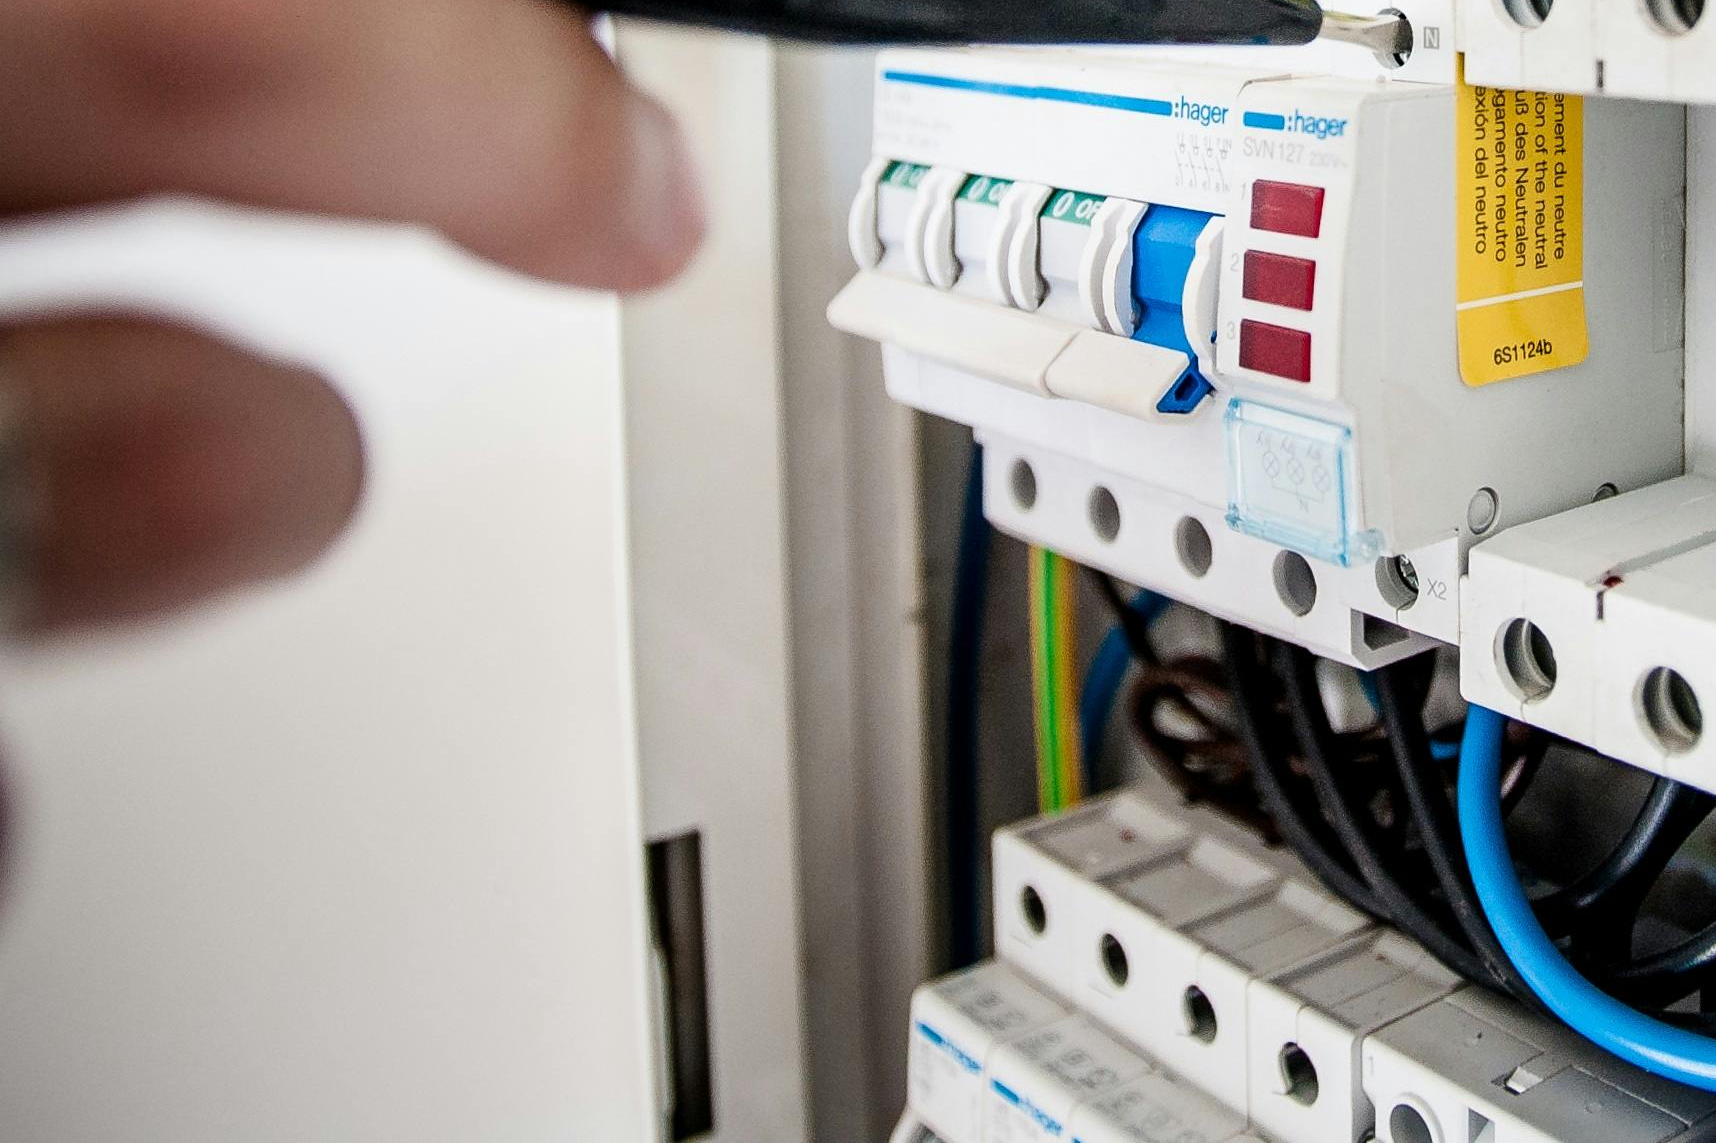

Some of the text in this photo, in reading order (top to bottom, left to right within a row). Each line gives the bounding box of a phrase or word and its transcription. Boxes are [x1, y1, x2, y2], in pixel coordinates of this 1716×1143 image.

[1425, 27, 1438, 48] N
[1242, 135, 1276, 162] SVN
[1278, 142, 1305, 164] 127
[1515, 122, 1529, 161] des
[1535, 134, 1549, 155] of
[1474, 148, 1489, 179] del
[1535, 161, 1549, 194] the
[1554, 162, 1567, 188] du
[1475, 186, 1489, 255] neutro
[1495, 195, 1509, 262] neutro
[1515, 167, 1529, 268] Neutralen
[1554, 195, 1567, 260] neutre
[1535, 200, 1549, 270] neutral
[1230, 252, 1240, 273] 2
[1226, 321, 1236, 340] 3
[1493, 338, 1553, 366] 6S1124b
[1426, 577, 1448, 601] X2
